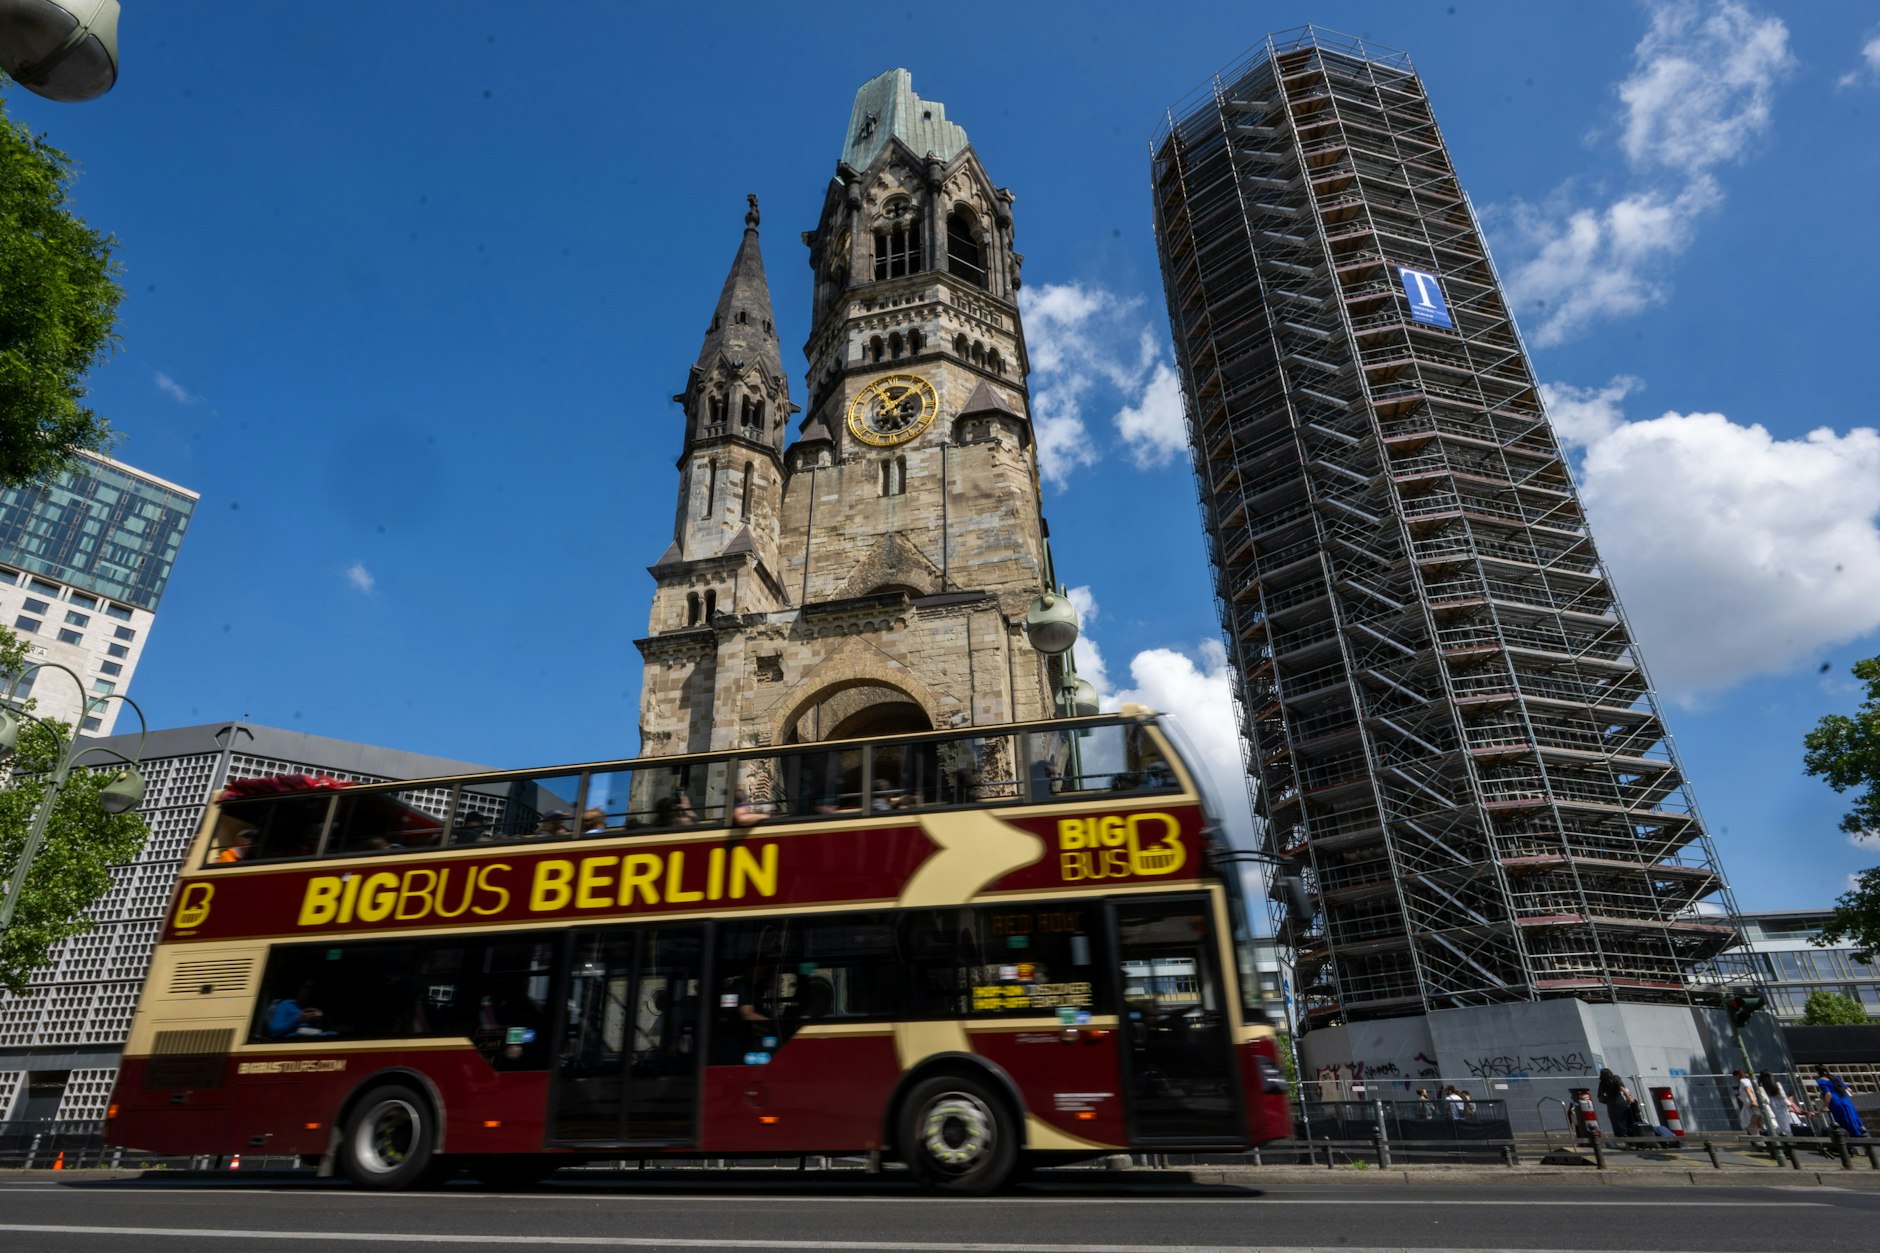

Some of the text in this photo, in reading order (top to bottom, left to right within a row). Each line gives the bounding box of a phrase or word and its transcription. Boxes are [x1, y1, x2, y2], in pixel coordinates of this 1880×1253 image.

[1400, 268, 1437, 309] T
[1057, 816, 1126, 850] BIG
[529, 843, 779, 912] BERLIN
[1060, 849, 1133, 881] BUS
